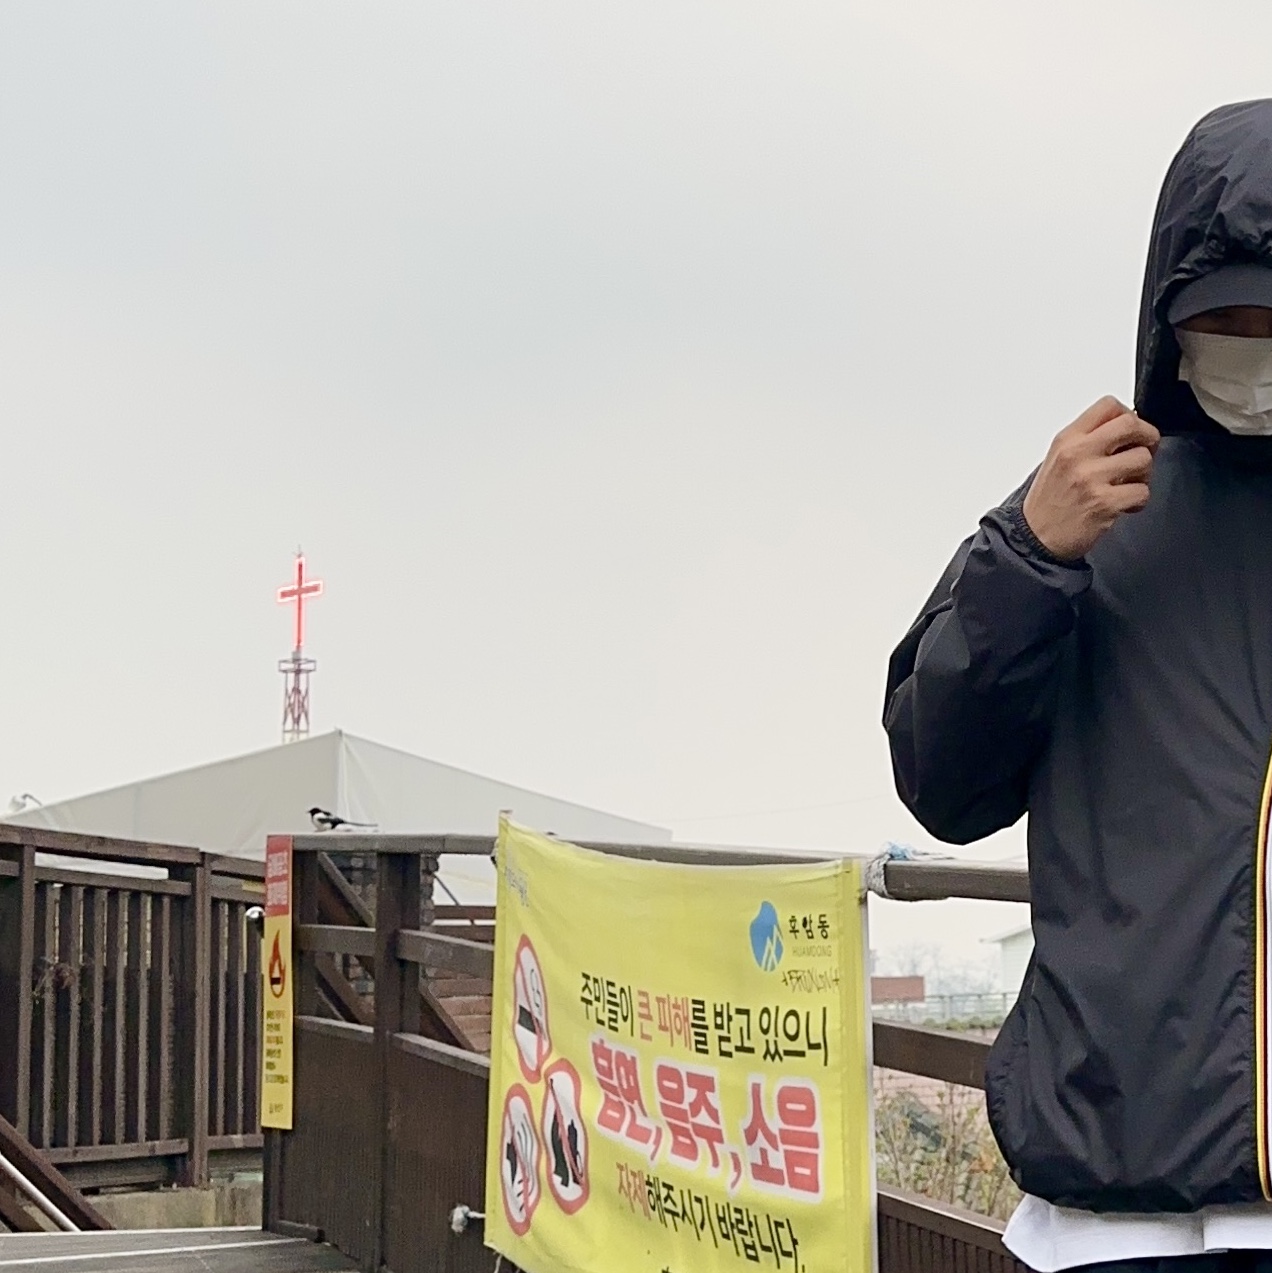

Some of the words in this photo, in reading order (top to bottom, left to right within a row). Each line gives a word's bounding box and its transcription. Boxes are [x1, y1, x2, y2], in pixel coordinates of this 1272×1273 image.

[789, 914, 830, 940] 후암동
[580, 972, 634, 1037] 주민들이
[637, 989, 653, 1042] 큰
[655, 994, 709, 1055] 피해를
[713, 1002, 755, 1058] 받고
[759, 1005, 828, 1066] 있으니
[743, 1082, 820, 1194] 소음
[616, 1162, 718, 1249] 자제해주시기
